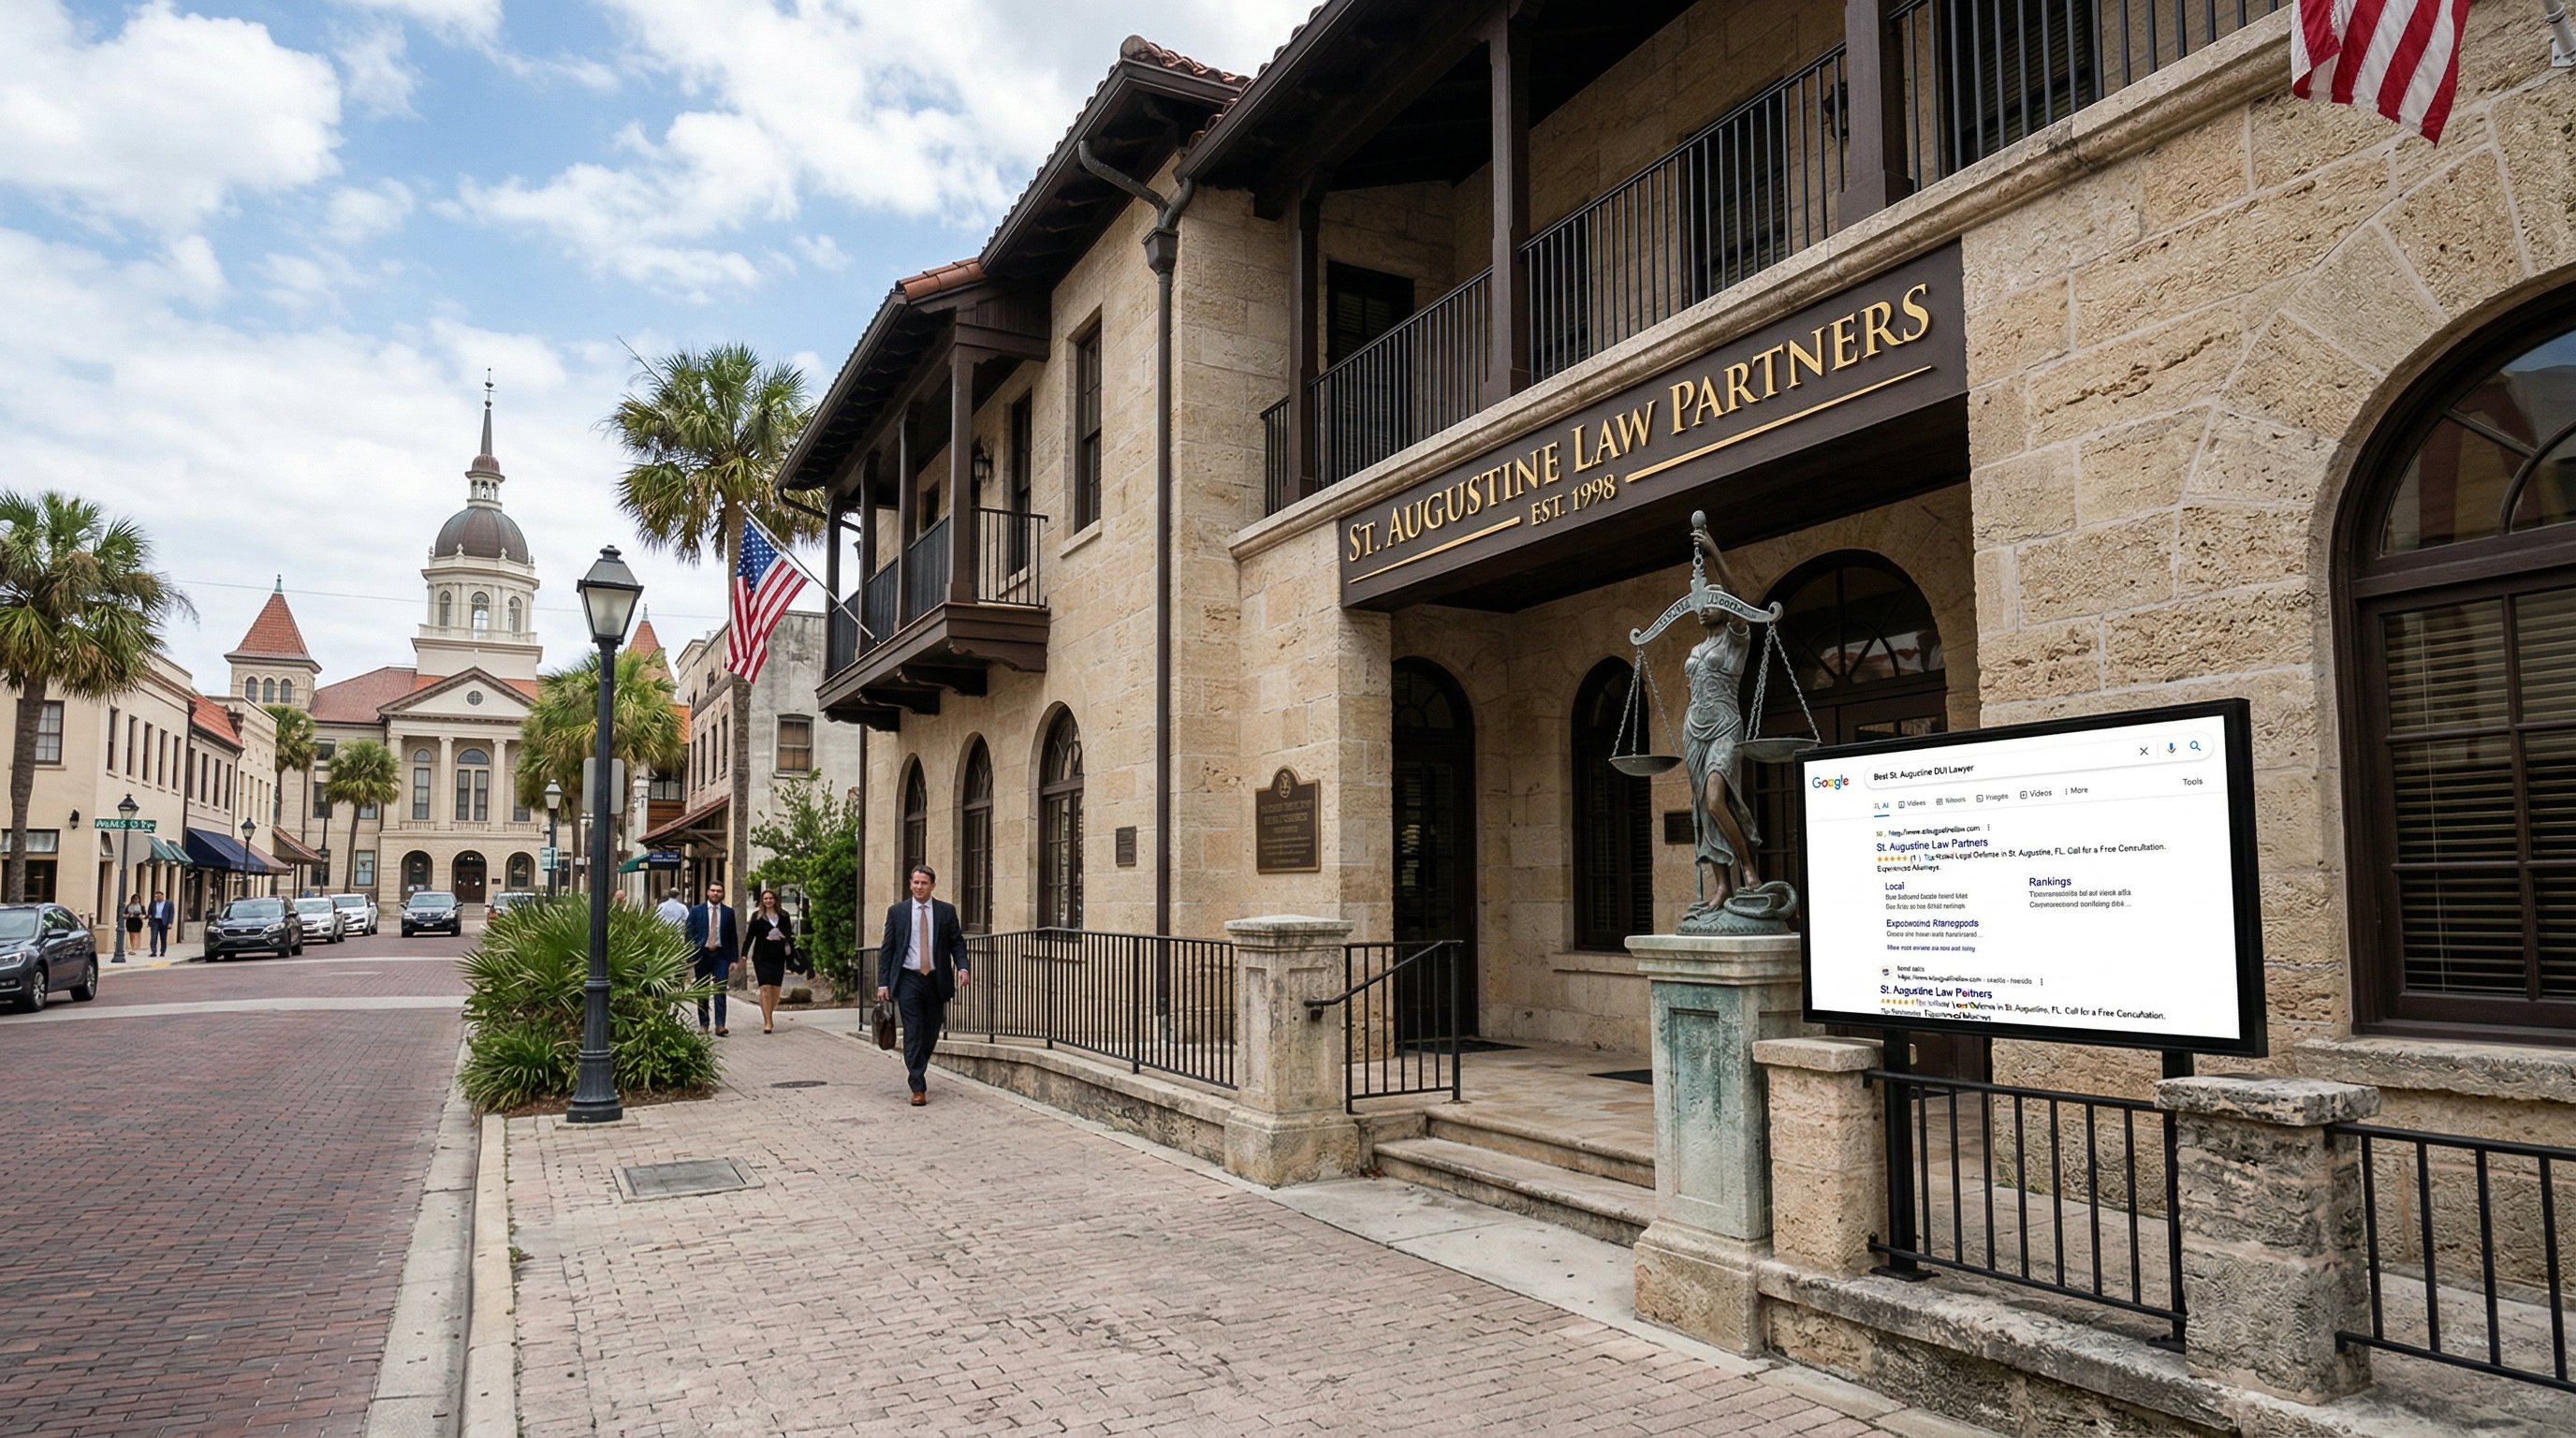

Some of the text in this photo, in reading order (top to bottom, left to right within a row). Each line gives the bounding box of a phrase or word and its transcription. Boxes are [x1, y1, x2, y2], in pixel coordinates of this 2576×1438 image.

[1348, 283, 1930, 563] ST. AUGUSTINE LAW PARTNERS
[1530, 474, 1617, 525] EST. 1998
[1877, 839, 1988, 853] St. Augustine Law Partners
[2019, 849, 2053, 858] Augustine,
[1885, 882, 1904, 890] Local
[2029, 877, 2071, 888] Rankings
[1936, 988, 1953, 996] Law
[2099, 1008, 2115, 1017] Free
